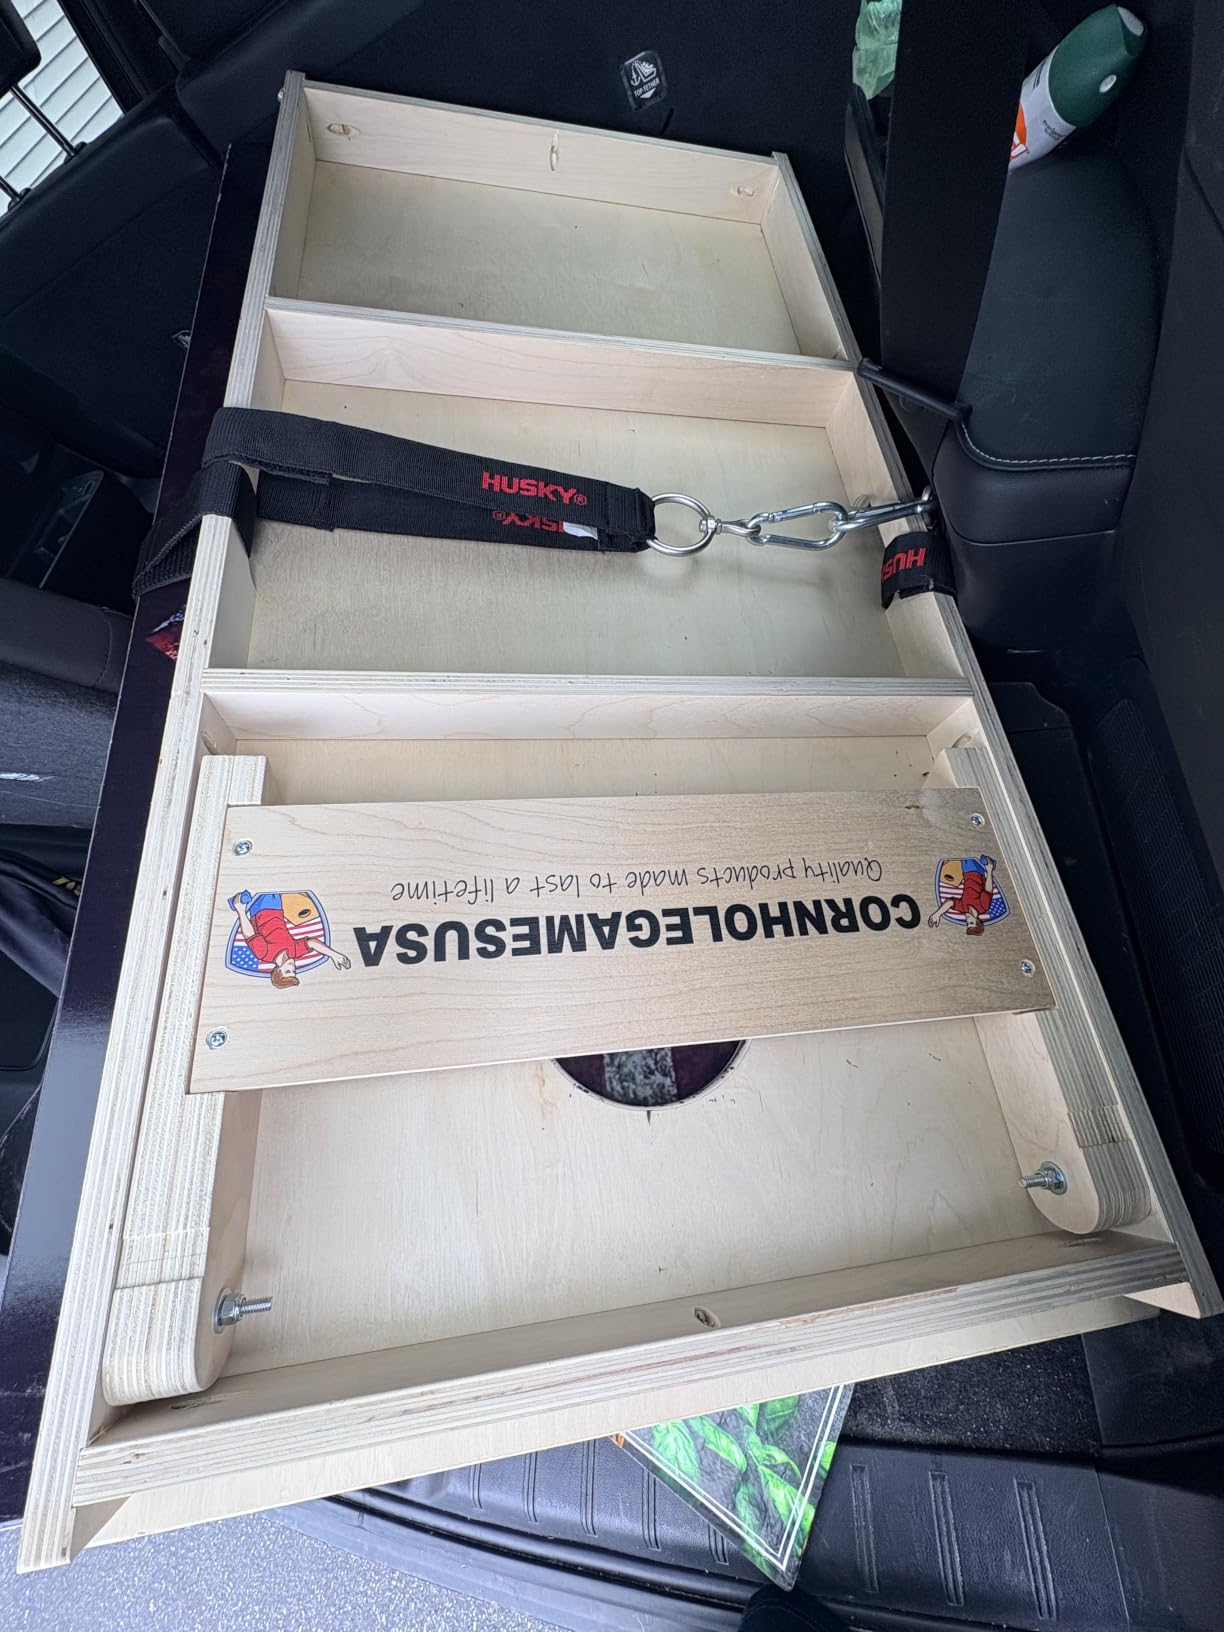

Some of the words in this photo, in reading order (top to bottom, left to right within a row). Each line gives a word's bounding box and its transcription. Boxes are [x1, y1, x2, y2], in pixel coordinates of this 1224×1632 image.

[589, 872, 617, 894] to
[625, 868, 689, 896] made
[696, 858, 798, 890] products
[802, 857, 883, 884] Quality
[390, 875, 494, 905] lifetime
[505, 876, 521, 895] a
[529, 874, 580, 899] last
[353, 893, 921, 967] CORNHOLEGAMESUSA
